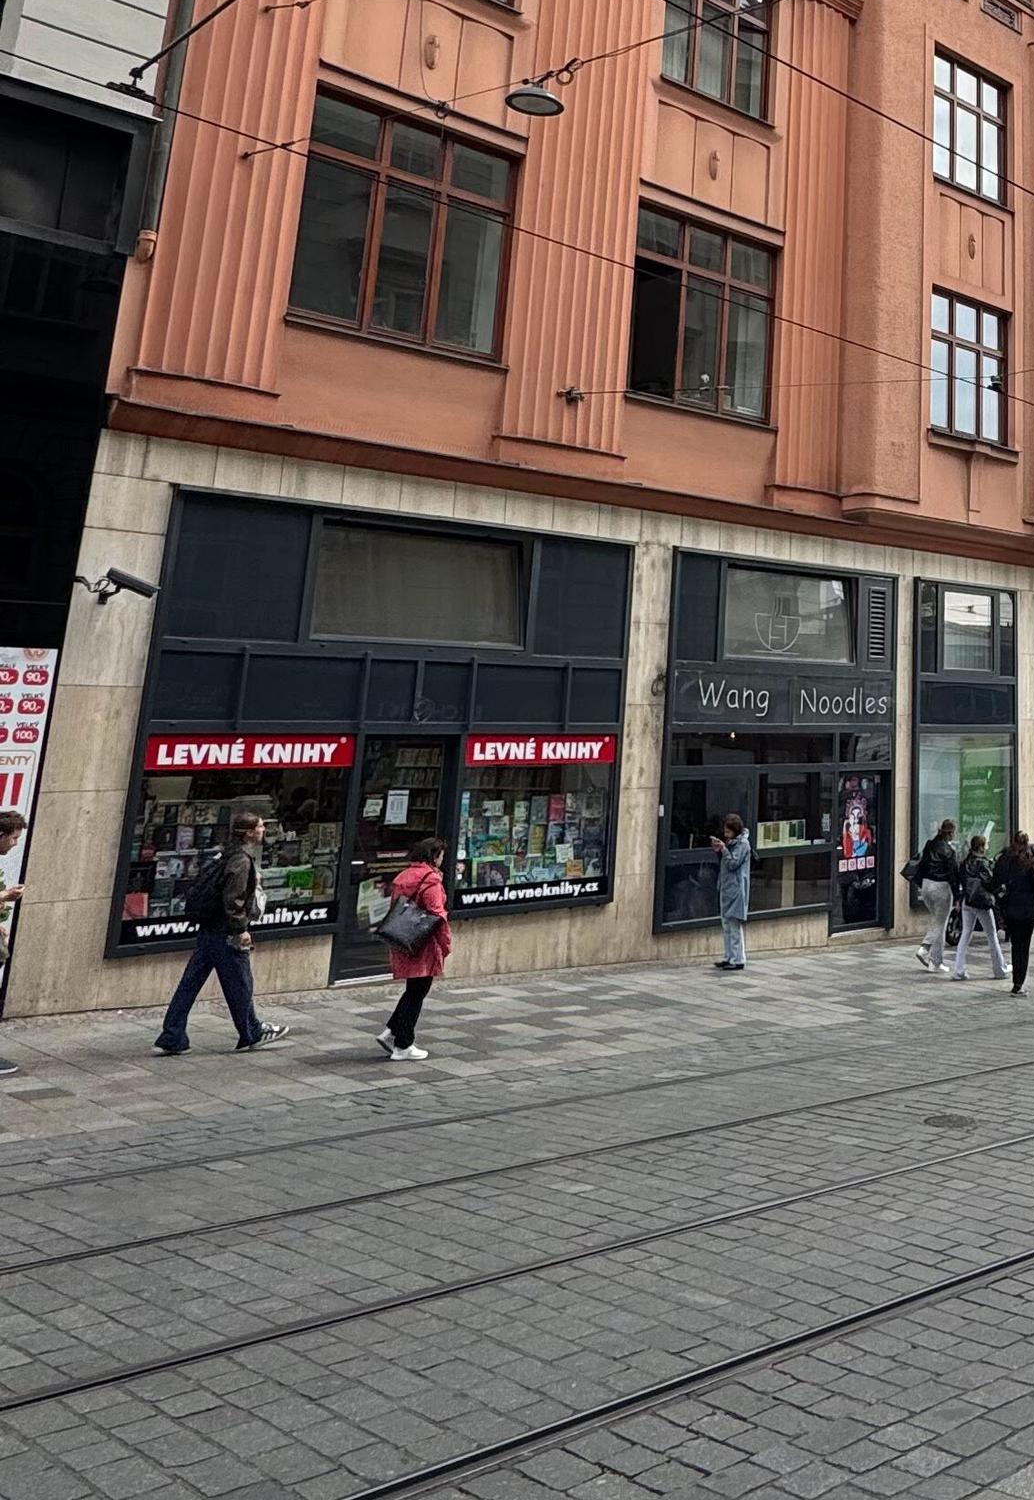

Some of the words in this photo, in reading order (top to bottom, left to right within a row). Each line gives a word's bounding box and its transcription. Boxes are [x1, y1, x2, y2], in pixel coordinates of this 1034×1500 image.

[698, 679, 770, 717] Wang
[799, 686, 888, 715] Noodles
[156, 737, 245, 766] LEVNÉ
[252, 742, 338, 764] KNIHY
[473, 737, 536, 761] LEVNÉ
[541, 741, 603, 760] KNIHY
[461, 881, 599, 905] www.levneknihy.cz
